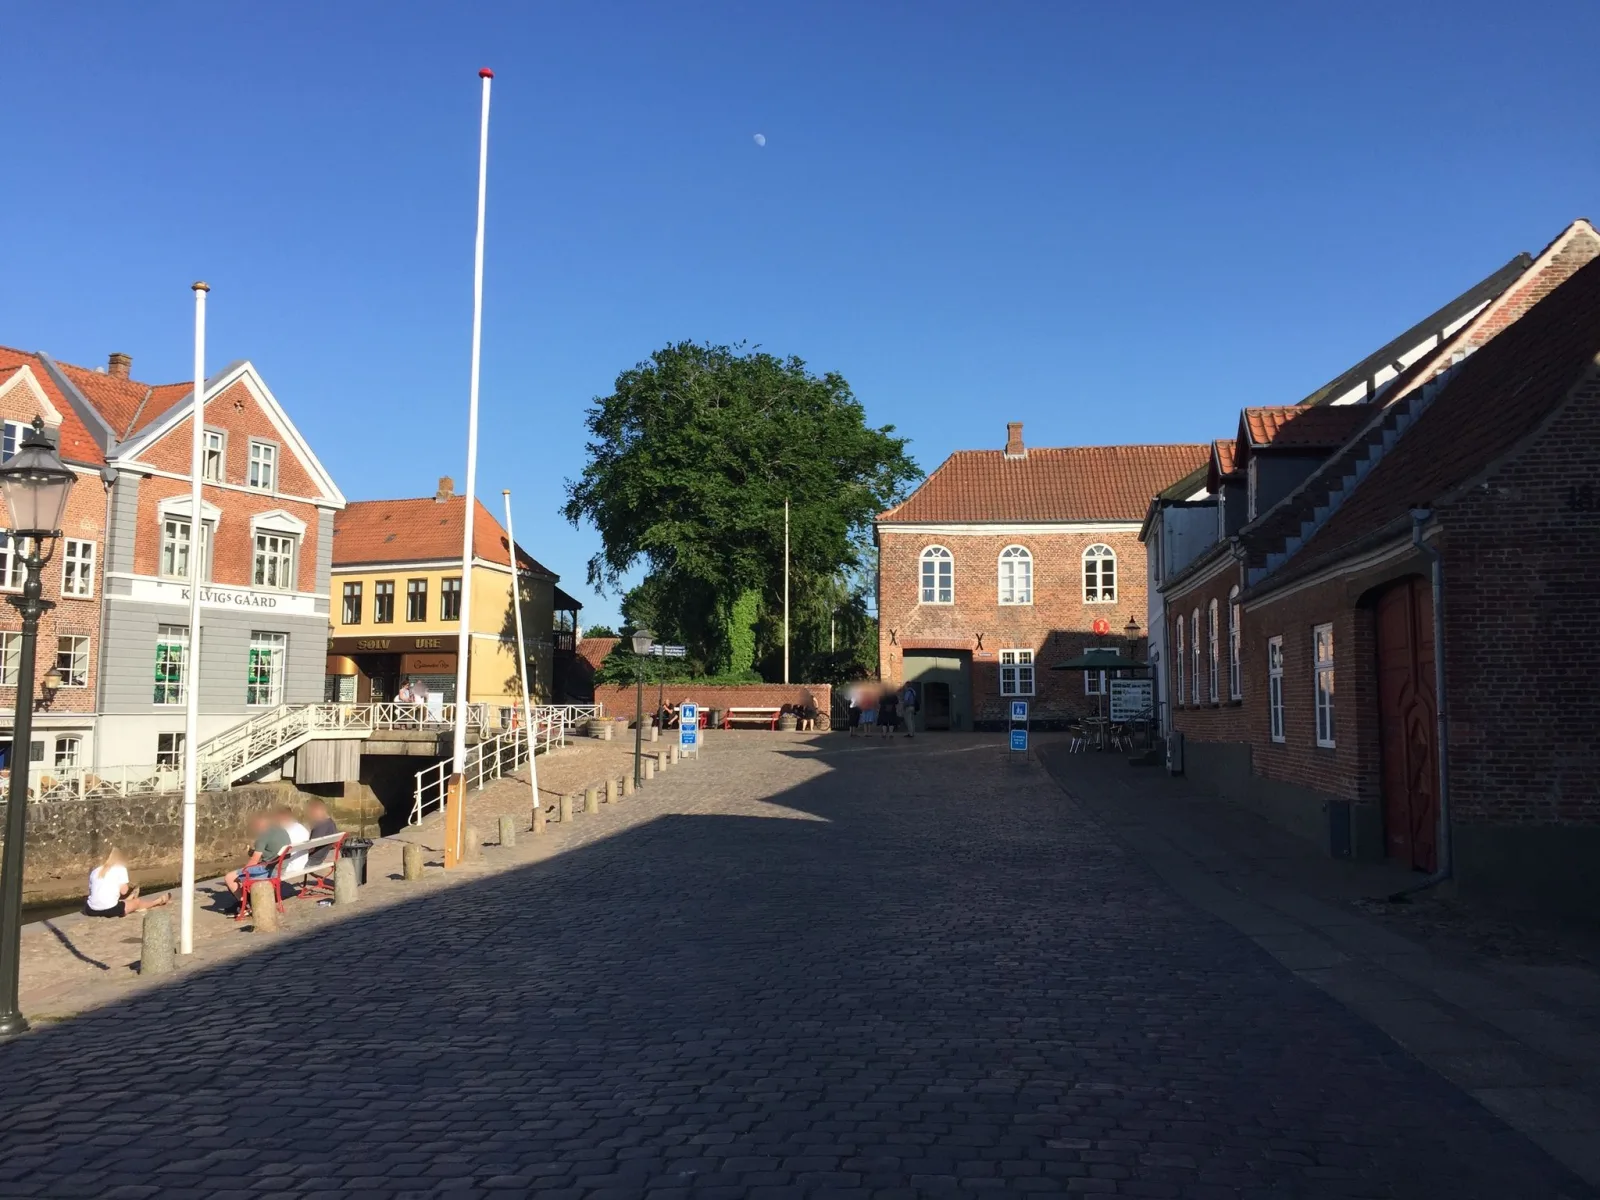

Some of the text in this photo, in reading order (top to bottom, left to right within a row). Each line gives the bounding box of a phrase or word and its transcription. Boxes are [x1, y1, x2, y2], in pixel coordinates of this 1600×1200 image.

[181, 588, 277, 608] KLVIGS GAARD
[415, 638, 442, 649] URE
